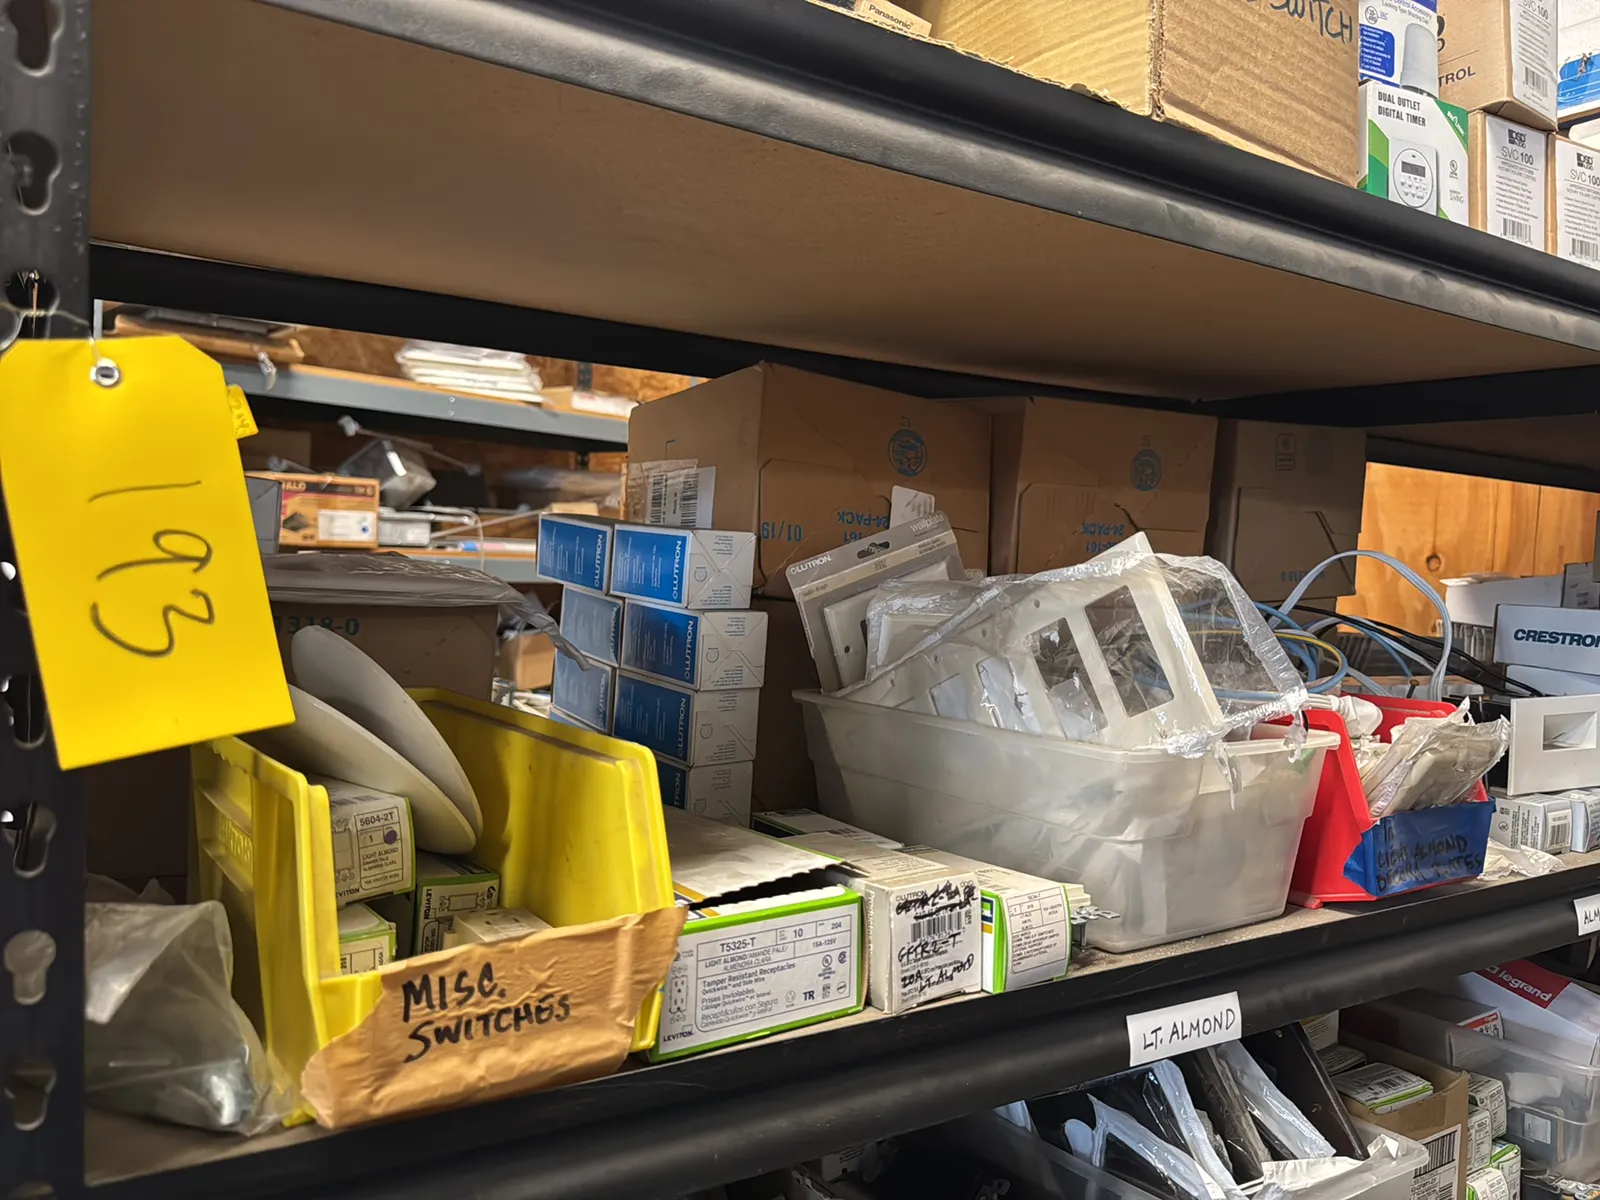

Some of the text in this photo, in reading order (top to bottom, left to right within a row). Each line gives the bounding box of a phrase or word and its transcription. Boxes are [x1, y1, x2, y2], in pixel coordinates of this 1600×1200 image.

[868, 4, 913, 30] Panasonic
[1537, 4, 1549, 20] 100
[1378, 91, 1420, 111] DUAL OUTLET
[1378, 105, 1426, 127] DIGITAL TIMER
[1502, 145, 1534, 166] SVC 100
[1570, 169, 1587, 183] SVC
[761, 521, 803, 543] 01/19
[910, 513, 945, 532] wallplate
[594, 534, 603, 582] LUTRON
[673, 540, 682, 594] LUTRON
[796, 555, 832, 573] LUTRON
[87, 481, 215, 658] 193
[685, 620, 694, 673] LUTRON
[678, 697, 687, 749] LUTRON
[360, 811, 394, 827] 5604-2T
[424, 888, 432, 920] LEVITON
[719, 921, 843, 953] T5325-T 10 204
[812, 938, 837, 948] 15A-125V
[705, 958, 722, 969] LIGHT
[723, 956, 772, 972] ALMENDRA CLARA
[702, 962, 796, 989] Tamper Resistant Receptacles
[732, 980, 742, 989] and
[1498, 970, 1553, 1002] legrand
[402, 961, 507, 1023] MISC.
[701, 988, 755, 1006] Prises Inviolables
[802, 990, 815, 1001] TR
[757, 998, 779, 1009] Seguro
[404, 994, 571, 1064] SWITCHES
[663, 1028, 694, 1042] LEVITON
[1142, 1008, 1236, 1051] LT. ALMOND
